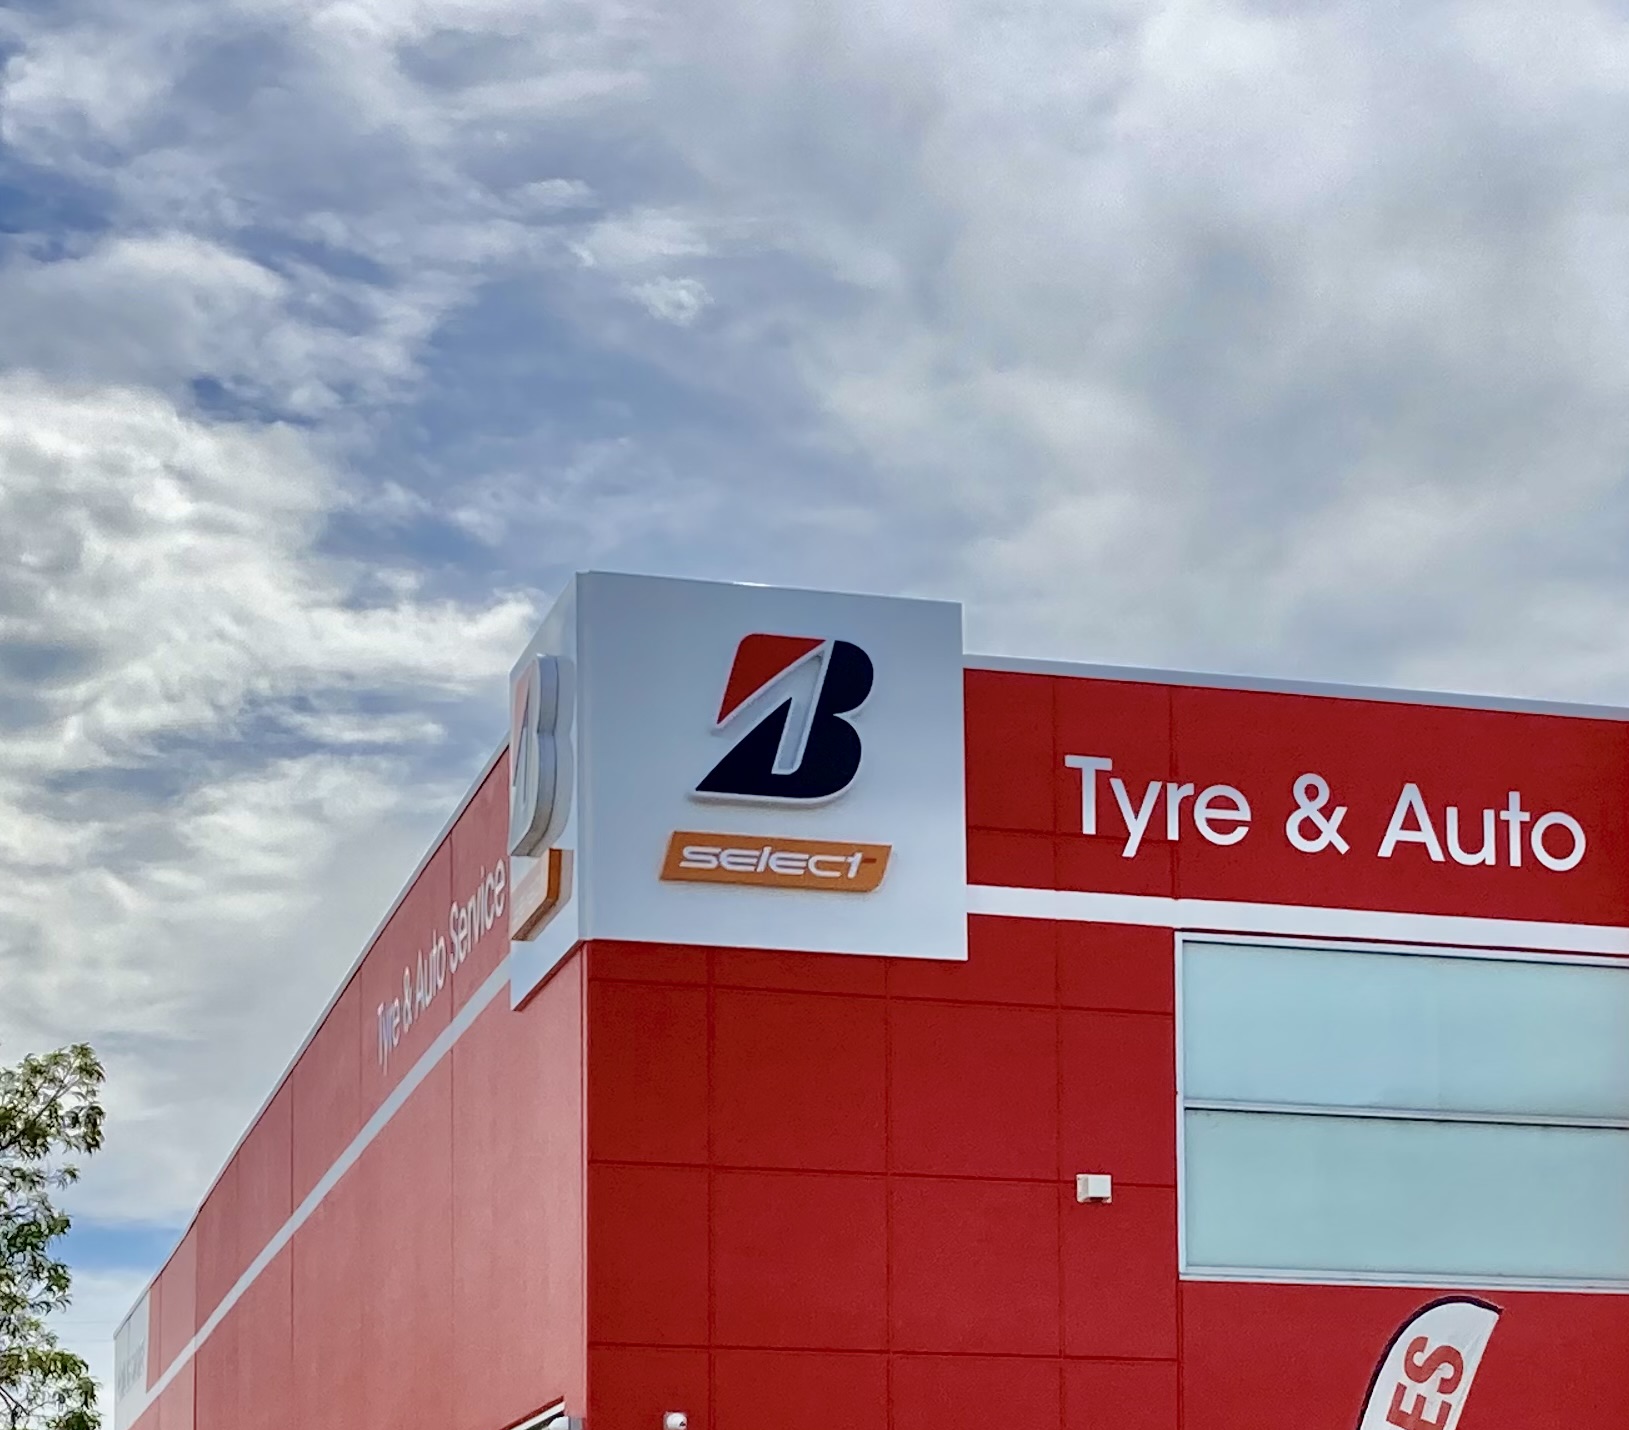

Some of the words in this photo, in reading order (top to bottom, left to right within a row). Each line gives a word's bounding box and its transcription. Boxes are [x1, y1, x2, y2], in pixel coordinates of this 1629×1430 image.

[1064, 754, 1252, 858] Tyre
[1285, 772, 1350, 856] &
[1377, 782, 1587, 872] Auto
[376, 996, 402, 1077] Tyre
[414, 930, 447, 1009] Auto
[447, 857, 506, 975] Service
